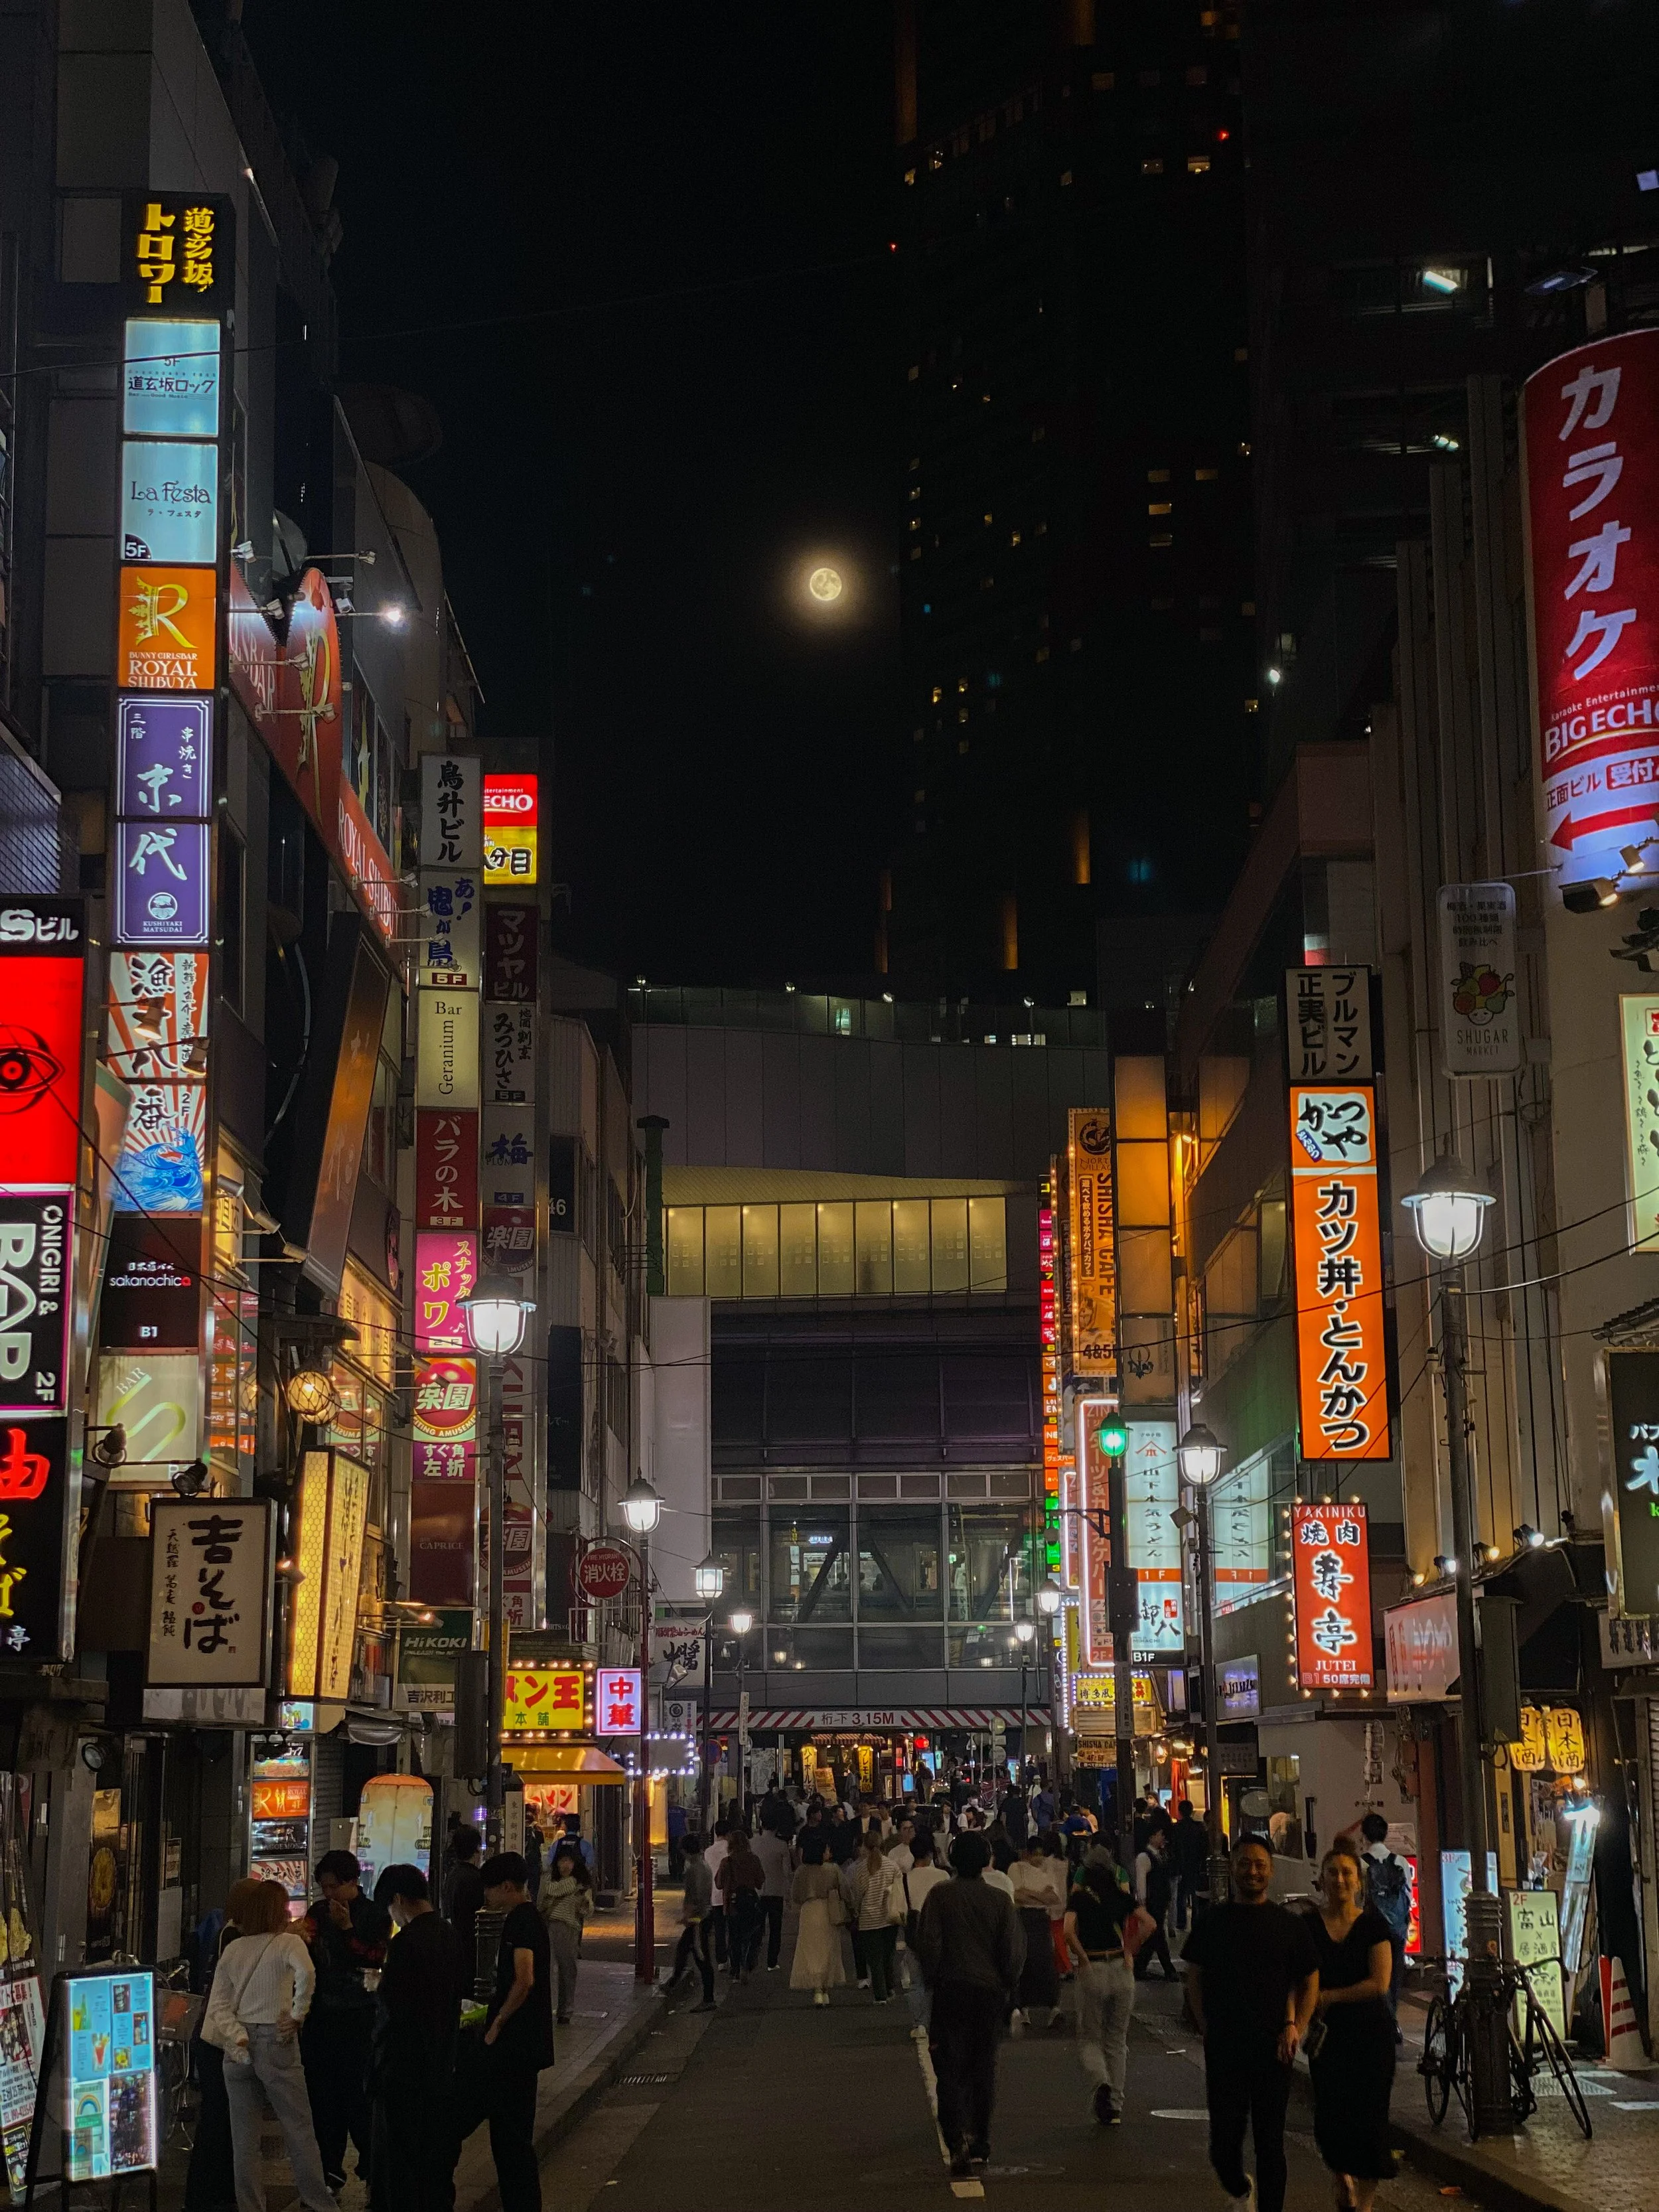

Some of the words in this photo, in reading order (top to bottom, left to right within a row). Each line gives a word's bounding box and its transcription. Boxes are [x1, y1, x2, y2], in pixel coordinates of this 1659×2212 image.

[137, 202, 177, 304] トロワー
[182, 206, 215, 293] 道玄坂
[128, 376, 216, 394] 道玄坂ロック
[131, 480, 159, 503] La
[162, 479, 212, 504] Festa
[1556, 365, 1639, 682] カラオケ
[125, 541, 147, 559] 5F
[129, 660, 198, 677] ROYAL
[128, 676, 197, 689] SHIBUYA
[1551, 701, 1583, 723] Karaoke
[1544, 715, 1587, 764] BIG
[1591, 697, 1659, 733] ECH
[178, 726, 197, 779] 串焼き
[498, 910, 526, 979] マツヤ
[494, 982, 530, 999] ビル
[435, 1001, 463, 1015] Bar
[1297, 972, 1327, 1076] 正実ビル
[1332, 971, 1360, 1074] ブルマン
[1457, 1028, 1508, 1044] SHUGAR
[438, 1019, 454, 1096] Geranium
[493, 1012, 515, 1089] みつひさ
[1466, 1045, 1499, 1057] MARKET
[430, 1115, 464, 1213] バラの木
[1097, 1172, 1115, 1241] SHISHA
[39, 1204, 64, 1293] ONIGIRI
[486, 1225, 534, 1250] 楽園
[109, 1273, 192, 1287] sakanochica
[1098, 1247, 1116, 1297] CAFE
[422, 1261, 451, 1330] ポワ
[38, 1301, 59, 1316] &
[139, 1325, 159, 1338] B1
[35, 1370, 56, 1402] 2F
[415, 1382, 474, 1410] 楽園
[423, 1443, 466, 1459] すぐ角
[423, 1458, 466, 1478] 左折
[1143, 1468, 1163, 1558] 山下本気うどん
[1294, 1506, 1366, 1519] YAKINIKU
[1301, 1520, 1360, 1546] 焼肉
[419, 1541, 465, 1550] CAPRICE
[183, 1514, 244, 1653] 吉そば
[583, 1561, 626, 1584] 消火栓
[1145, 1570, 1165, 1579] 1F
[404, 1637, 468, 1649] HiKOKI
[1133, 1651, 1155, 1662] B1F
[1315, 1660, 1357, 1672] JUTEI
[1301, 1672, 1320, 1684] B1
[607, 1676, 635, 1728] 中華
[1080, 1687, 1114, 1700] 博多風
[515, 1712, 549, 1727] 本舗
[851, 1712, 895, 1726] 3.15M
[1078, 1739, 1102, 1749] SHISHA
[1557, 1712, 1579, 1768] 日本酒
[1512, 1893, 1528, 1905] 2F
[1518, 1908, 1555, 1930] 富山
